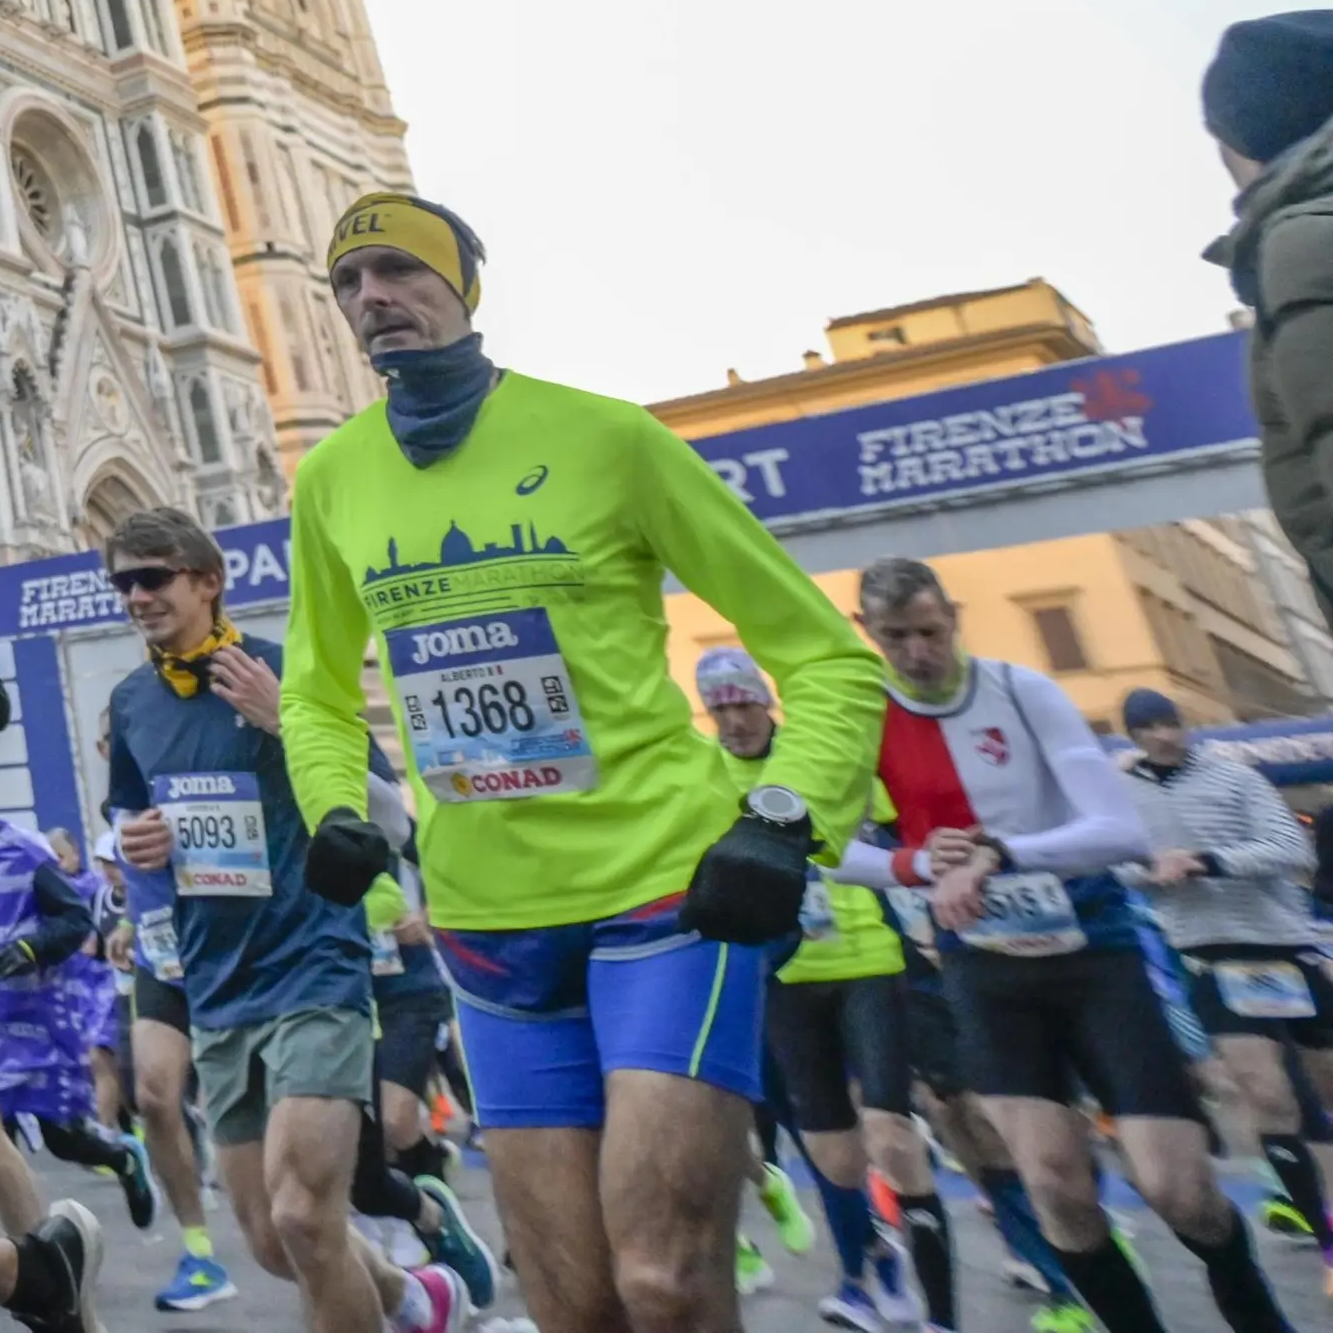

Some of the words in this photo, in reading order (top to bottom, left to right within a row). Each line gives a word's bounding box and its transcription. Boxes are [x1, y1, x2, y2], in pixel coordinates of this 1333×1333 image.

[857, 391, 1087, 462] FIRENZE
[857, 415, 1150, 496] MARATHON
[222, 539, 291, 591] PA
[364, 577, 452, 610] FIRENZE
[440, 667, 485, 683] ALBERTO
[432, 680, 537, 739] 1368
[471, 766, 563, 793] CONAD
[178, 814, 237, 849] 5093
[193, 871, 247, 887] CONAD
